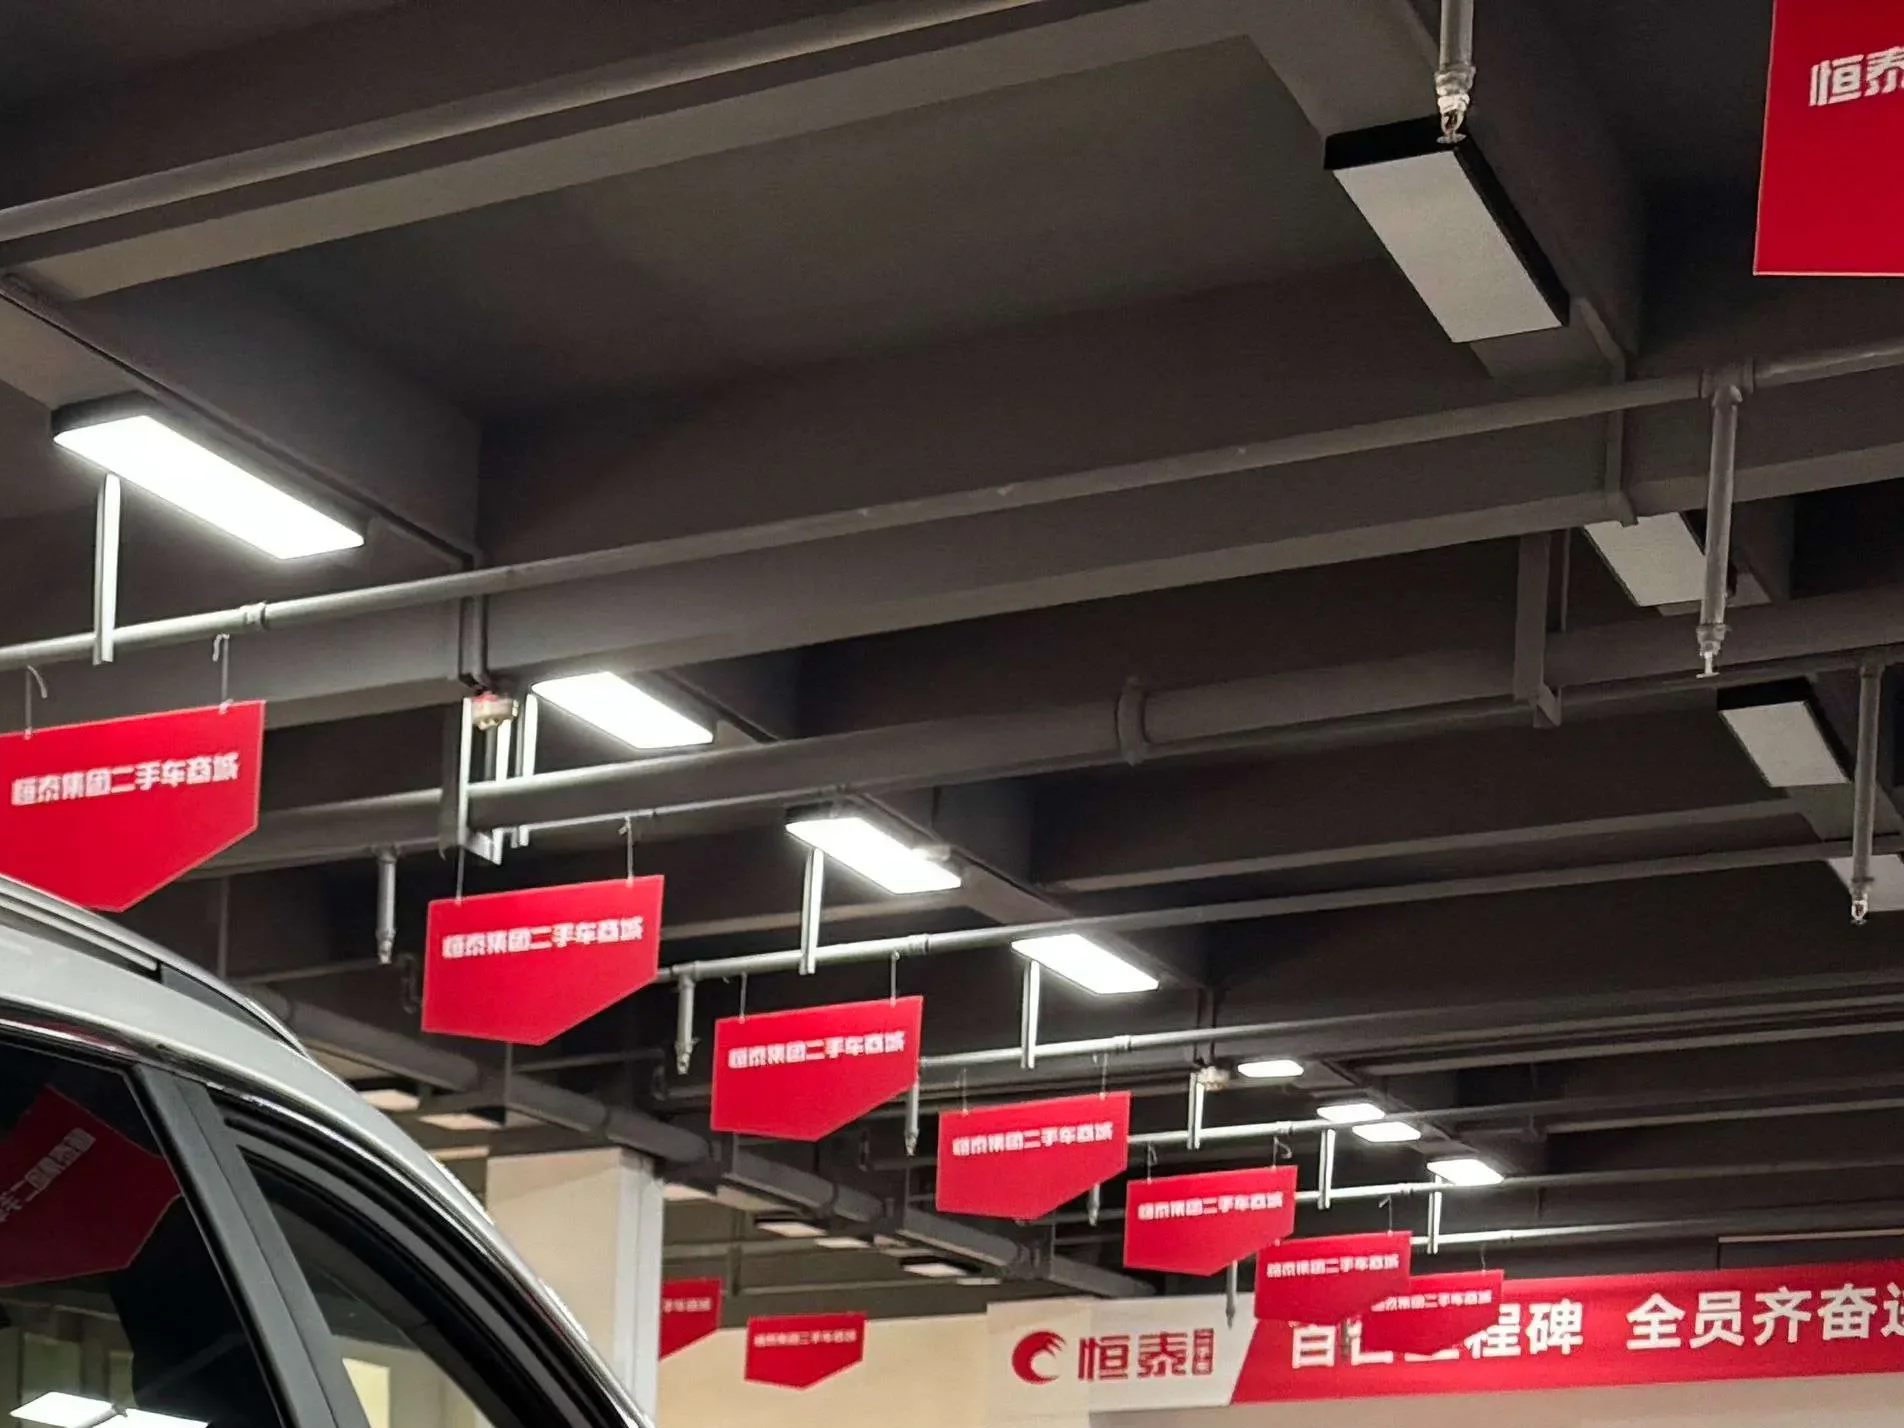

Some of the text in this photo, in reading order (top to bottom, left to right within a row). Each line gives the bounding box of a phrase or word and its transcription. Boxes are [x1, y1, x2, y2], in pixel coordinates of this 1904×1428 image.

[11, 752, 240, 806] 恒泰集团二手车商城
